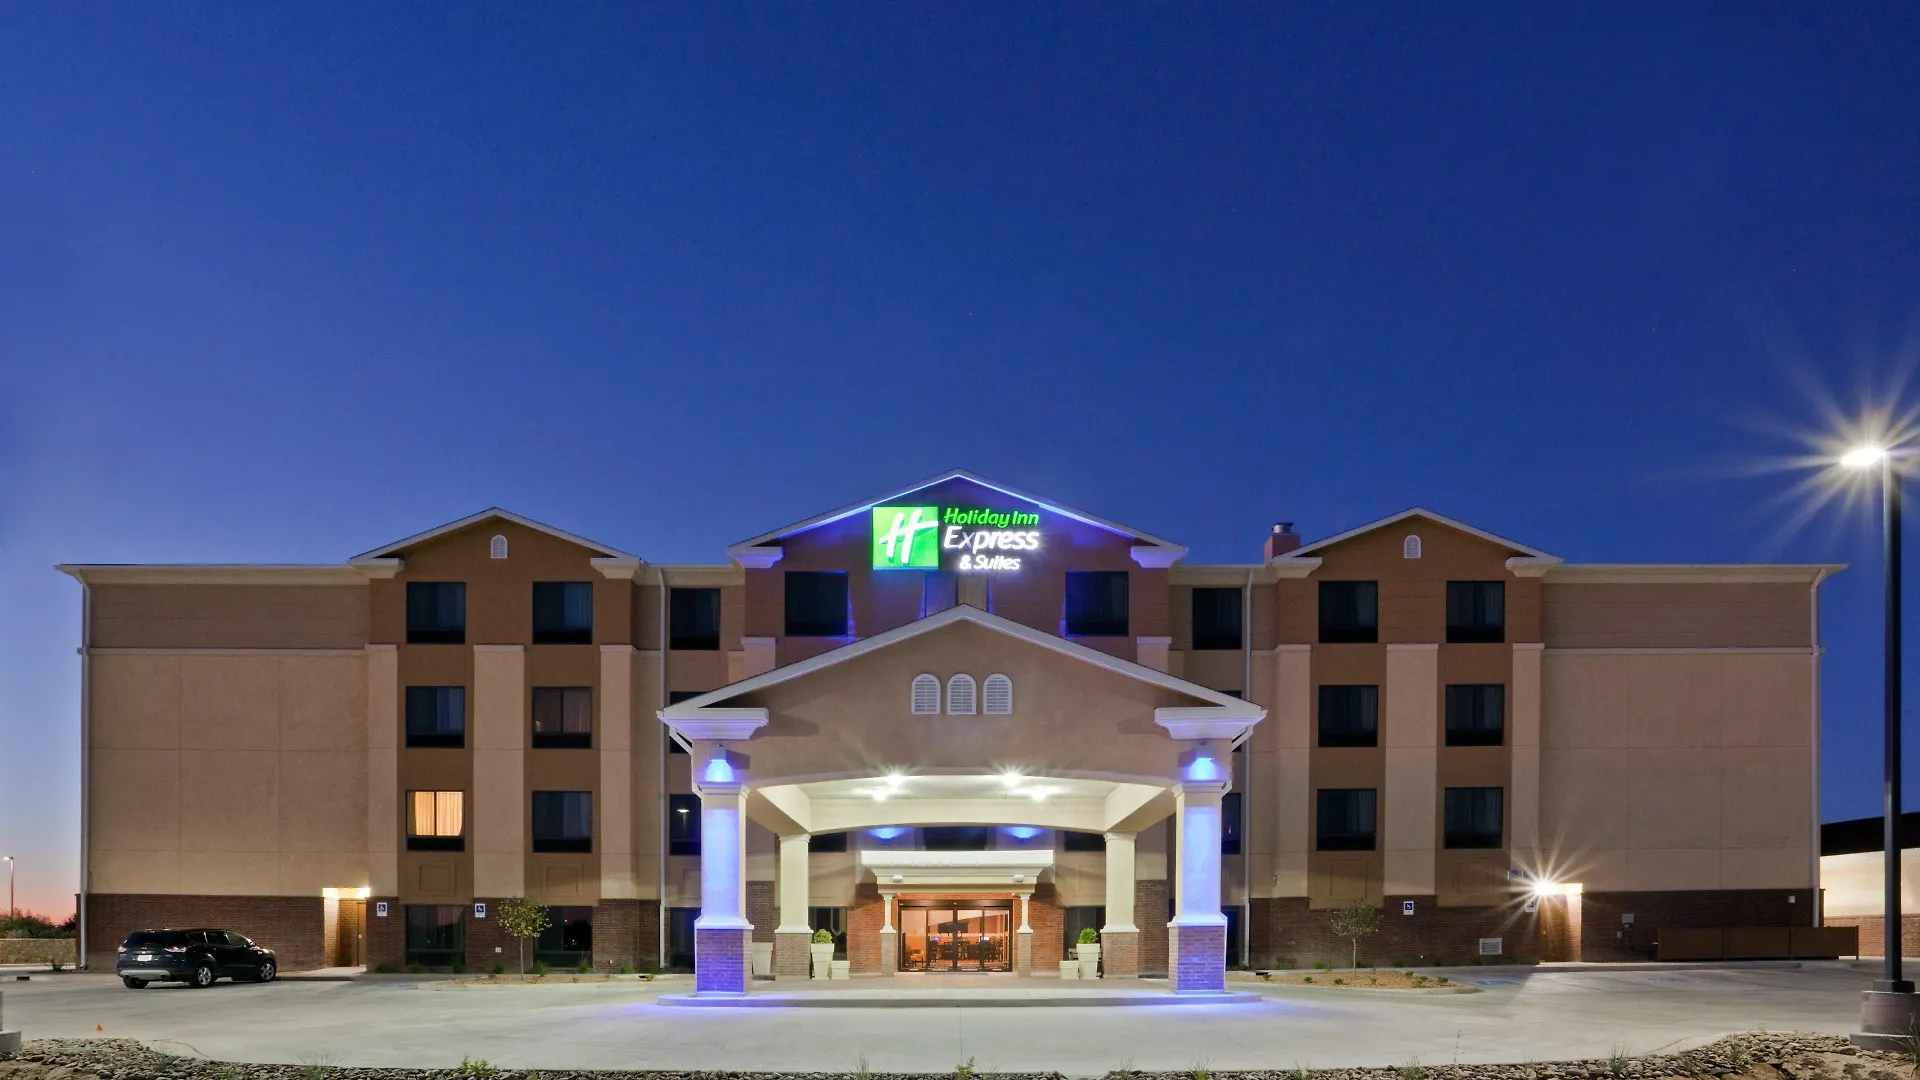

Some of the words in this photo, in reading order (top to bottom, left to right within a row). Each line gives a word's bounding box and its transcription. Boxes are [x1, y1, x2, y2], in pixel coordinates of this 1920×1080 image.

[944, 507, 1010, 528] Holiday
[1012, 511, 1039, 525] Inn
[879, 509, 938, 563] H
[943, 525, 1040, 554] Express
[959, 555, 972, 570] &
[973, 555, 1021, 570] Suites
